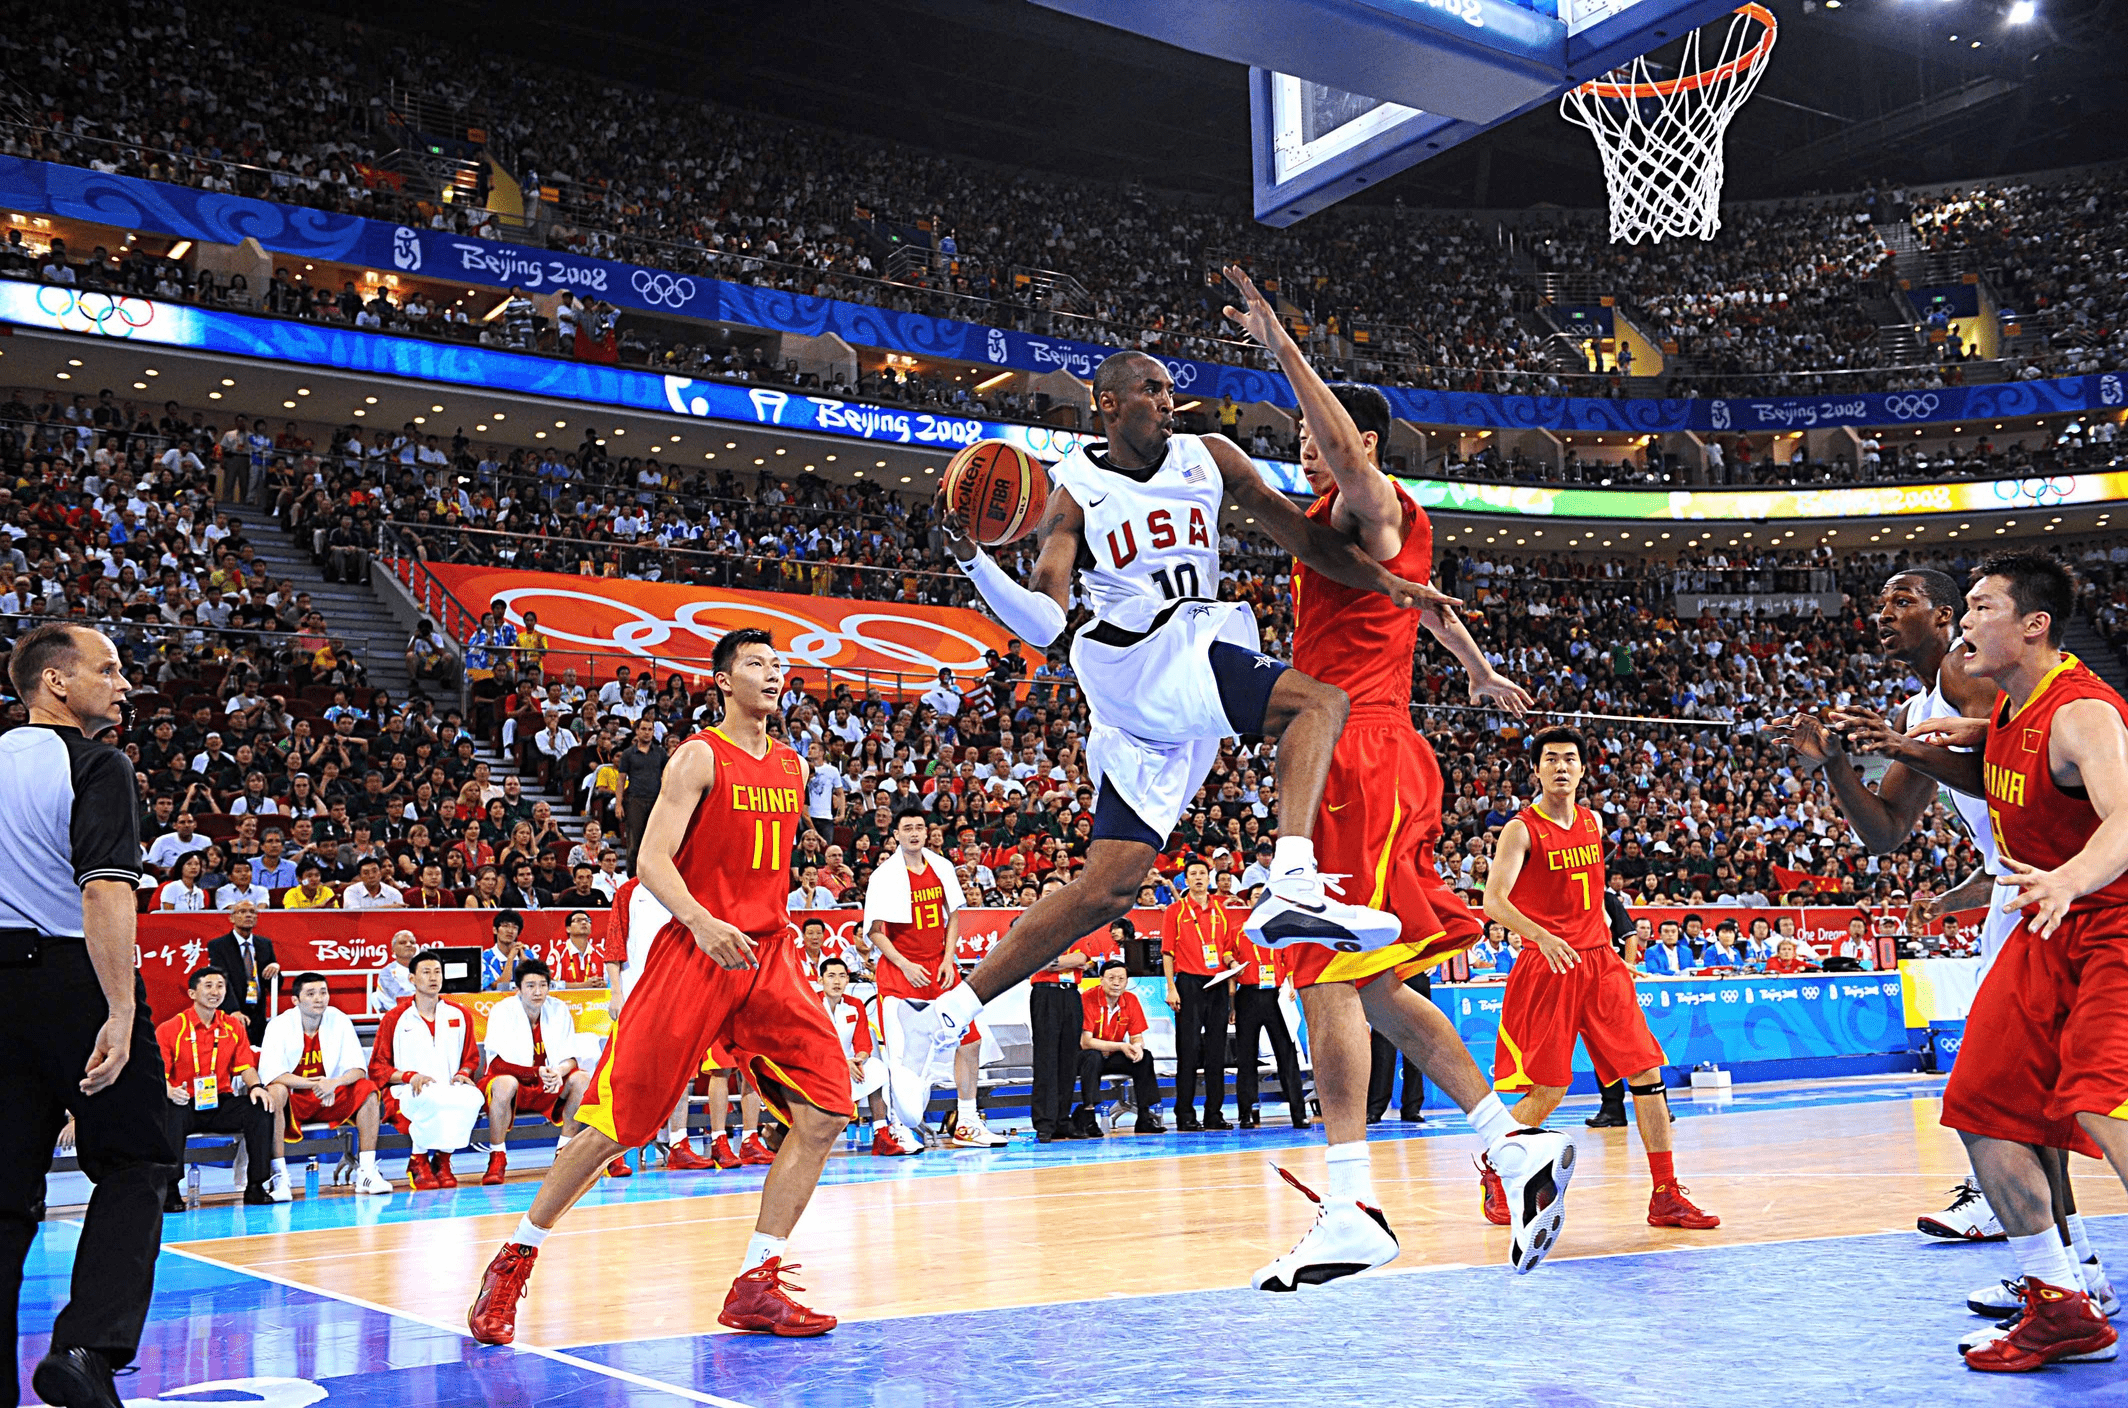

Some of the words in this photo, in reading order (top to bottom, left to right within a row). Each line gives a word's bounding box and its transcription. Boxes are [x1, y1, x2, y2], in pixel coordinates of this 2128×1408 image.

[451, 242, 543, 287] Beijing
[547, 261, 608, 292] 2008
[1026, 341, 1091, 375] Beijing
[806, 396, 910, 443] Beijing
[915, 415, 984, 446] 2008
[1750, 401, 1818, 426] Beijing
[1820, 400, 1868, 419] 2008
[957, 455, 987, 525] molten
[988, 478, 1011, 511] FIBA
[1881, 486, 1953, 511] 2008
[1105, 507, 1210, 570] USA
[1148, 563, 1199, 600] 10
[732, 783, 799, 814] CHINA
[1984, 761, 2026, 808] HINA
[751, 818, 781, 871] 11
[1547, 843, 1601, 871] CHINA
[1571, 871, 1591, 911] 7
[914, 903, 940, 930] 13
[1797, 927, 1815, 942] One
[308, 938, 389, 967] Beijing
